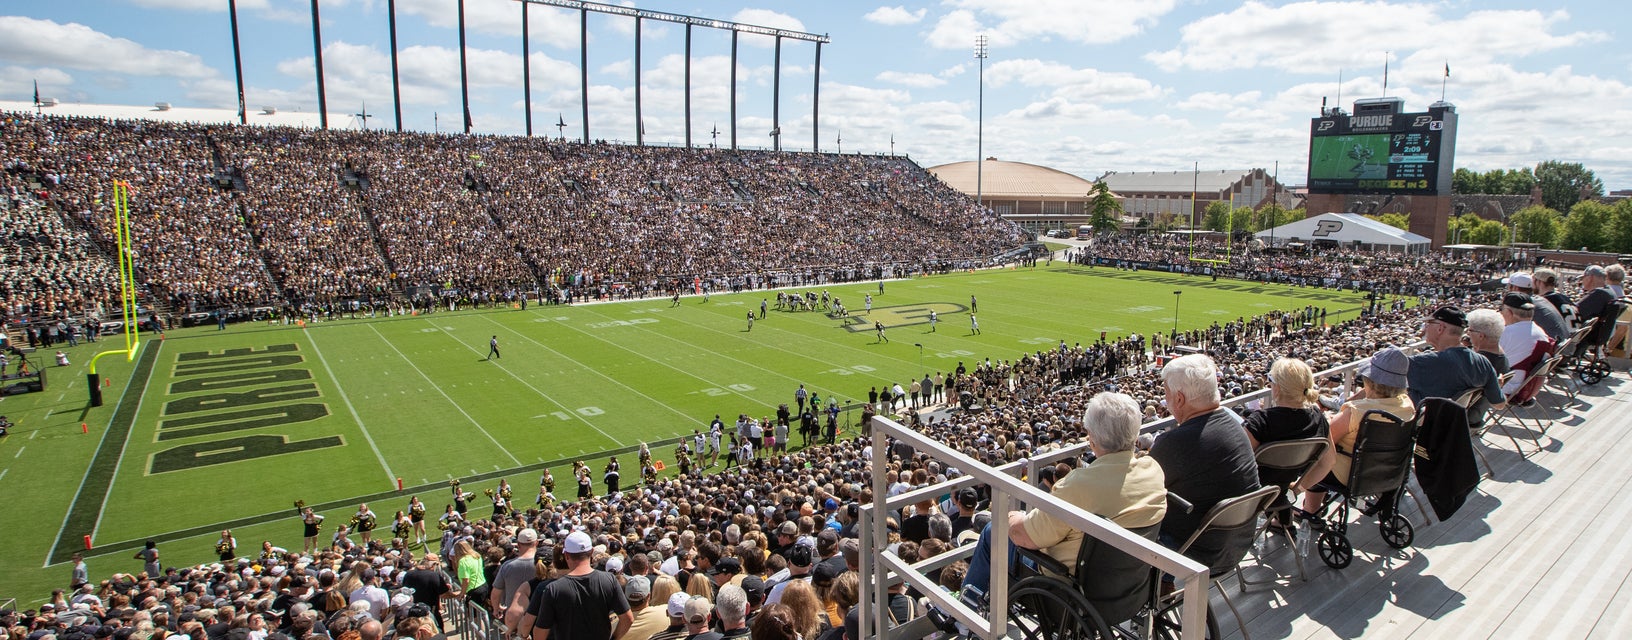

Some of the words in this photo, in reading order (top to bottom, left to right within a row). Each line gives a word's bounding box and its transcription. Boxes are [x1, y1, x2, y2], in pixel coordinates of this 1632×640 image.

[1317, 120, 1335, 131] P
[1349, 115, 1393, 128] PURDUE
[1358, 180, 1406, 189] DEGREE
[1418, 179, 1428, 189] 3
[1312, 220, 1343, 236] P
[701, 383, 757, 397] 20
[144, 342, 348, 476] PURDUE
[549, 406, 606, 421] 10
